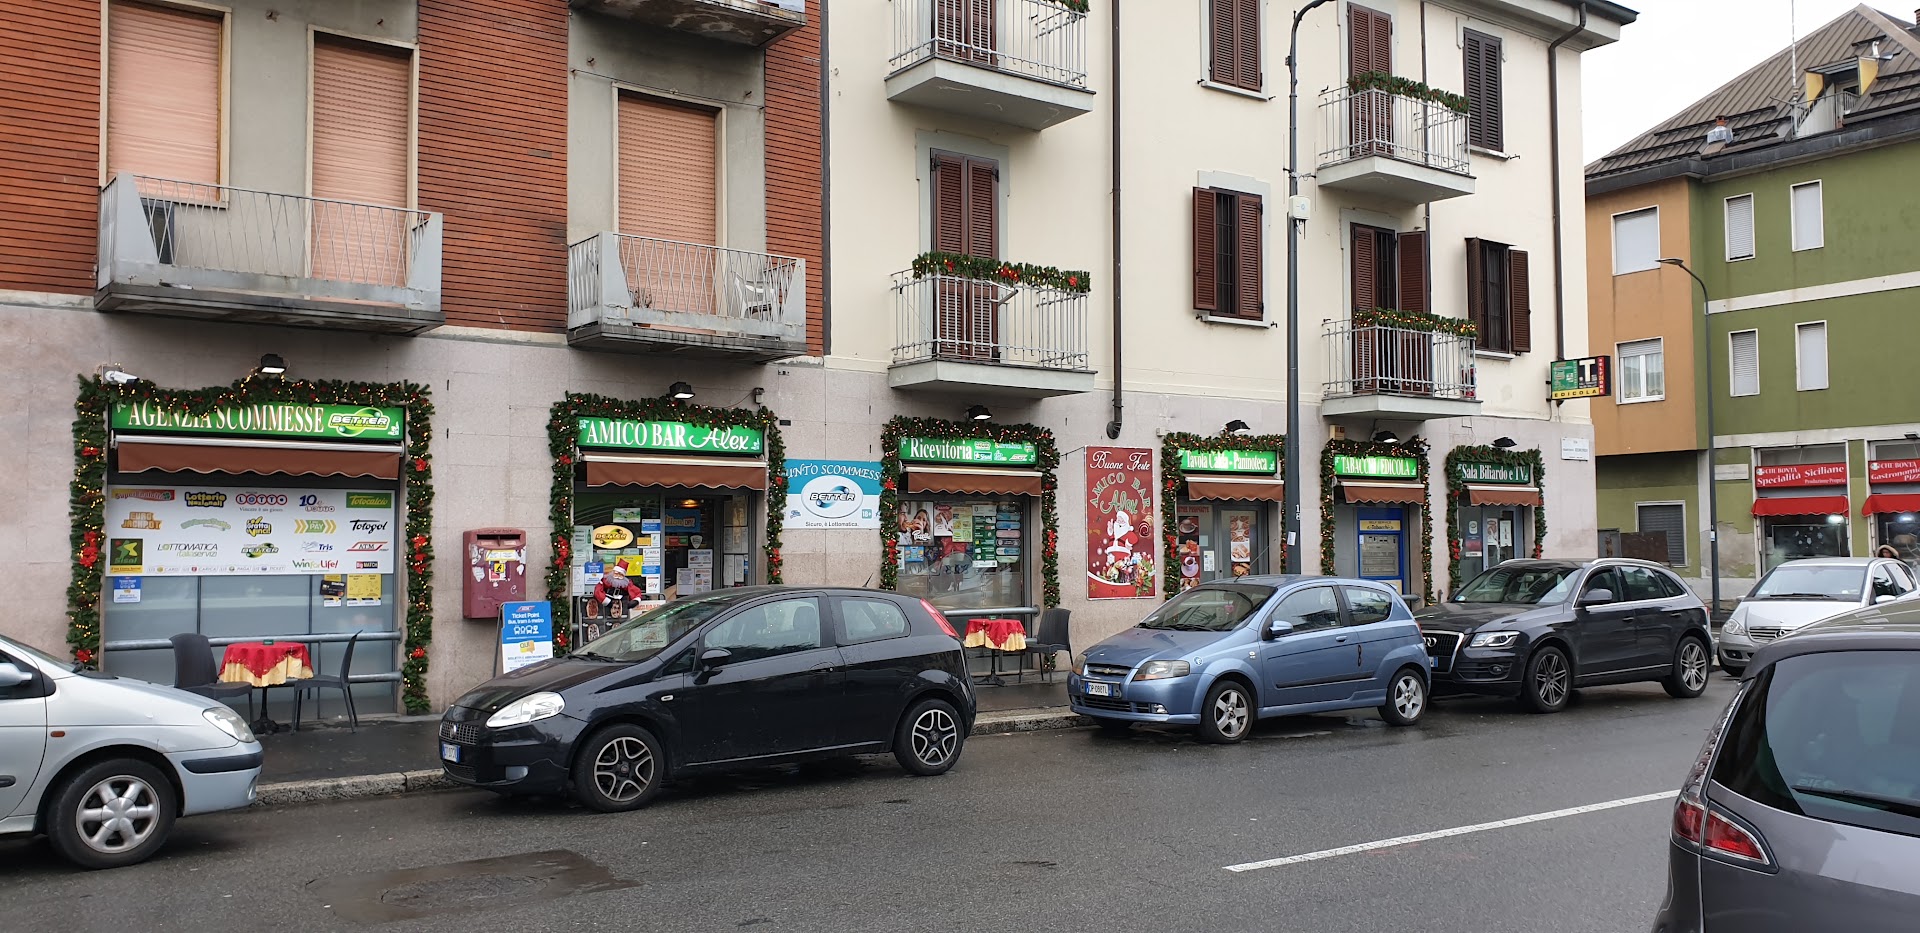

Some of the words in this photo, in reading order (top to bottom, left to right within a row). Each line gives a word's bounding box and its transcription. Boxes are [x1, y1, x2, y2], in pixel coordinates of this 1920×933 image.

[1579, 359, 1595, 382] T
[1554, 389, 1597, 398] EDICOLA
[216, 402, 324, 433] SCOMMESSE
[331, 414, 388, 426] BETTER
[586, 420, 648, 446] AMICO
[651, 423, 687, 448] BAR
[688, 426, 750, 451] Alex
[909, 437, 972, 461] Ricevitoria
[1090, 450, 1124, 469] Buone
[1187, 449, 1208, 469] Tavola
[1233, 451, 1268, 471] Paninoteca
[1381, 458, 1410, 476] EDICOLA
[785, 463, 819, 479] UNTO
[820, 464, 882, 481] SCOMMESS
[1462, 463, 1478, 480] Sala
[1479, 464, 1508, 480] Biliardo
[1508, 469, 1514, 481] e
[1804, 466, 1845, 478] Siciliane
[186, 493, 226, 501] Lotterie
[809, 492, 856, 501] BETTER
[1090, 472, 1126, 509] AMICO
[1131, 477, 1151, 508] BAR
[236, 494, 288, 506] LOTTO
[299, 494, 317, 507] 10
[350, 495, 389, 506] Totocalcio
[1100, 489, 1139, 515] Alex
[129, 512, 154, 520] EURO
[350, 519, 388, 535] Totogol
[157, 543, 218, 551] LOTTOMATICA
[319, 543, 333, 551] Tris
